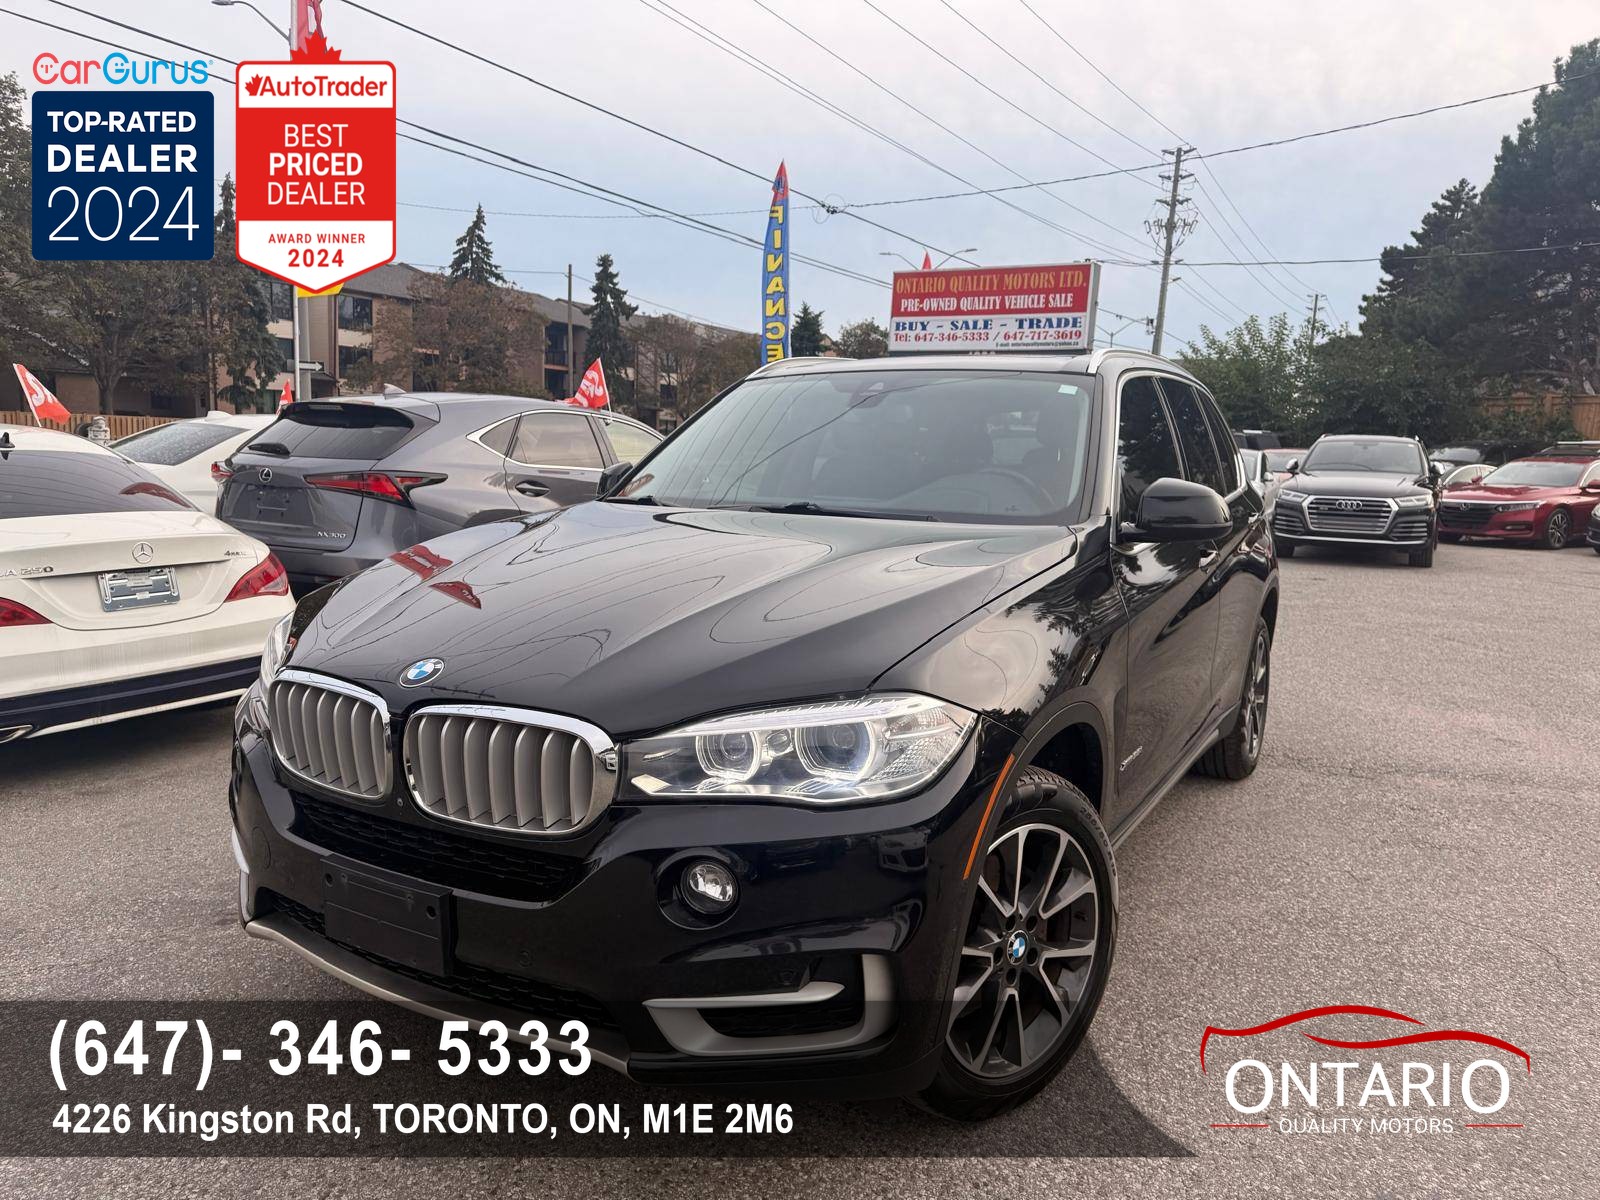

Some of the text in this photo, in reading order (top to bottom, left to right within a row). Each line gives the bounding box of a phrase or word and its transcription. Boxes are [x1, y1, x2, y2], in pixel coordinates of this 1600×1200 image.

[896, 270, 1087, 294] ONTARIO QUALITY MOTORS LTD.
[900, 293, 1073, 312] PRE-OWNED QUALITY VEHICLE SALE
[895, 321, 930, 332] BUY
[950, 319, 993, 331] SALE
[1015, 316, 1082, 329] TRADE
[894, 332, 911, 343] Tel:
[914, 331, 990, 343] 647-346-5333
[1003, 329, 1082, 342] 647-717-3619
[19, 565, 54, 576] 250
